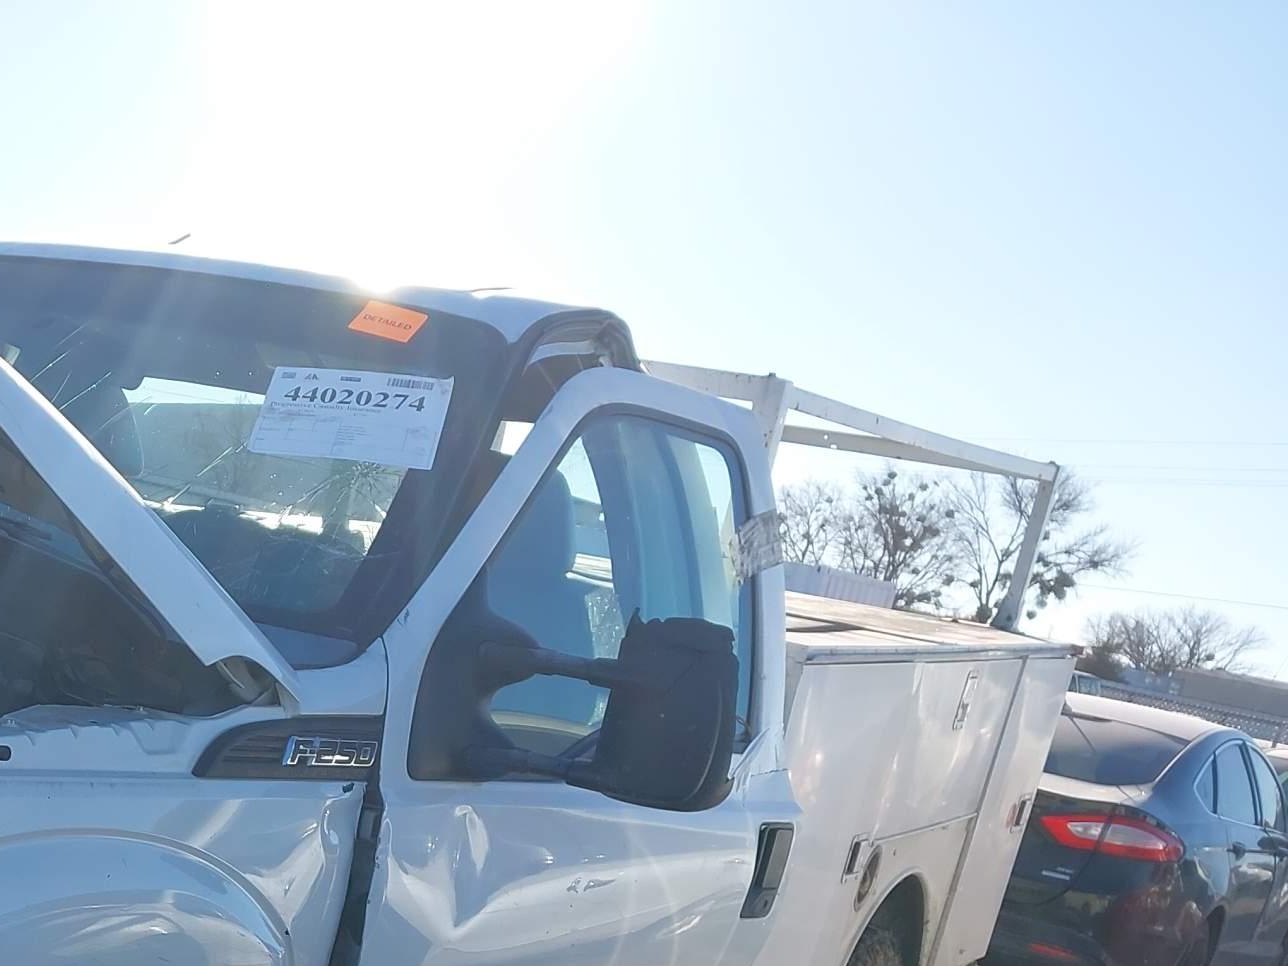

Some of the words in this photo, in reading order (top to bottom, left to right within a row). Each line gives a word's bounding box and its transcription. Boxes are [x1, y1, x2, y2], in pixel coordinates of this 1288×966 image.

[363, 313, 412, 330] DETAILED
[284, 386, 425, 412] 44020274
[283, 735, 378, 767] F-250
